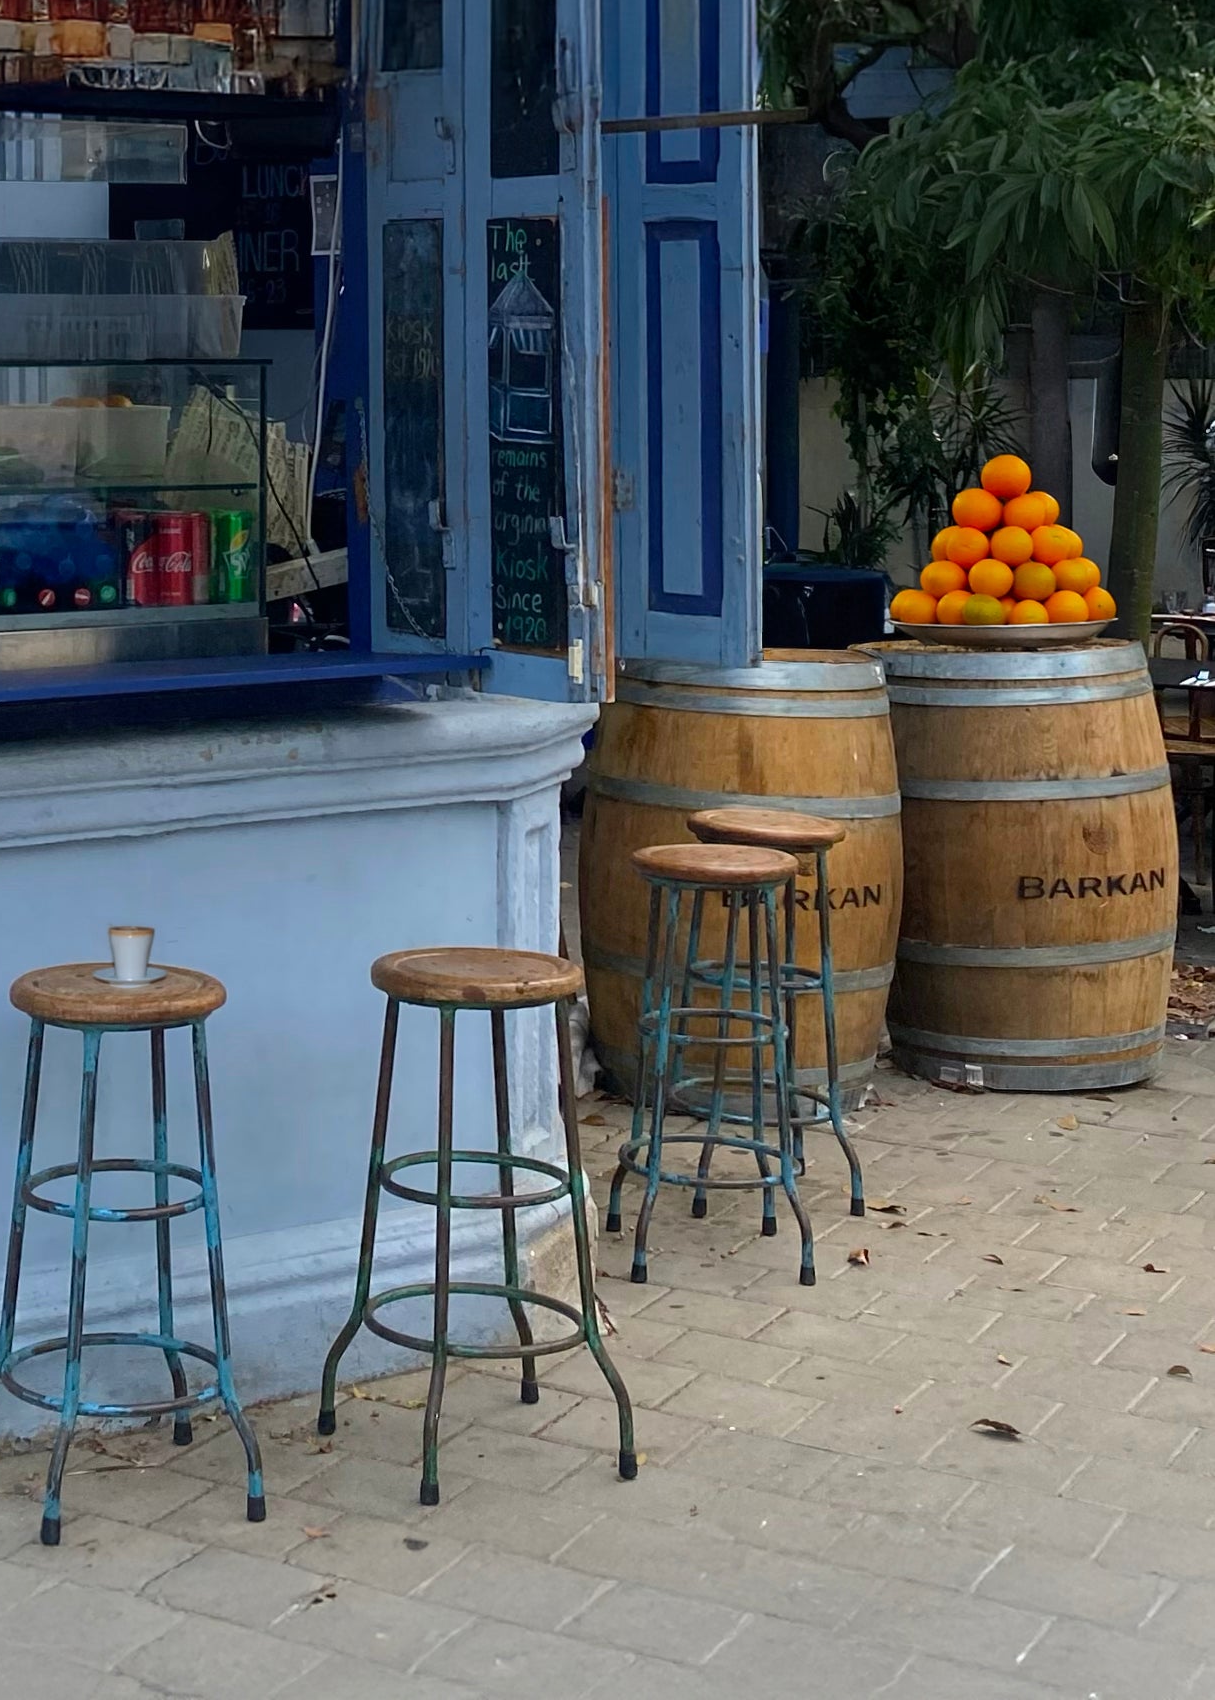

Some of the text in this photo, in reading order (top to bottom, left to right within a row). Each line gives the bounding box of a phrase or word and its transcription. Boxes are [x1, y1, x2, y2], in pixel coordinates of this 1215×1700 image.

[488, 220, 527, 254] The
[492, 449, 547, 469] remains
[493, 471, 541, 503] of the
[495, 584, 543, 613] Since
[505, 615, 547, 645] 1920
[1017, 866, 1167, 902] BARKAN
